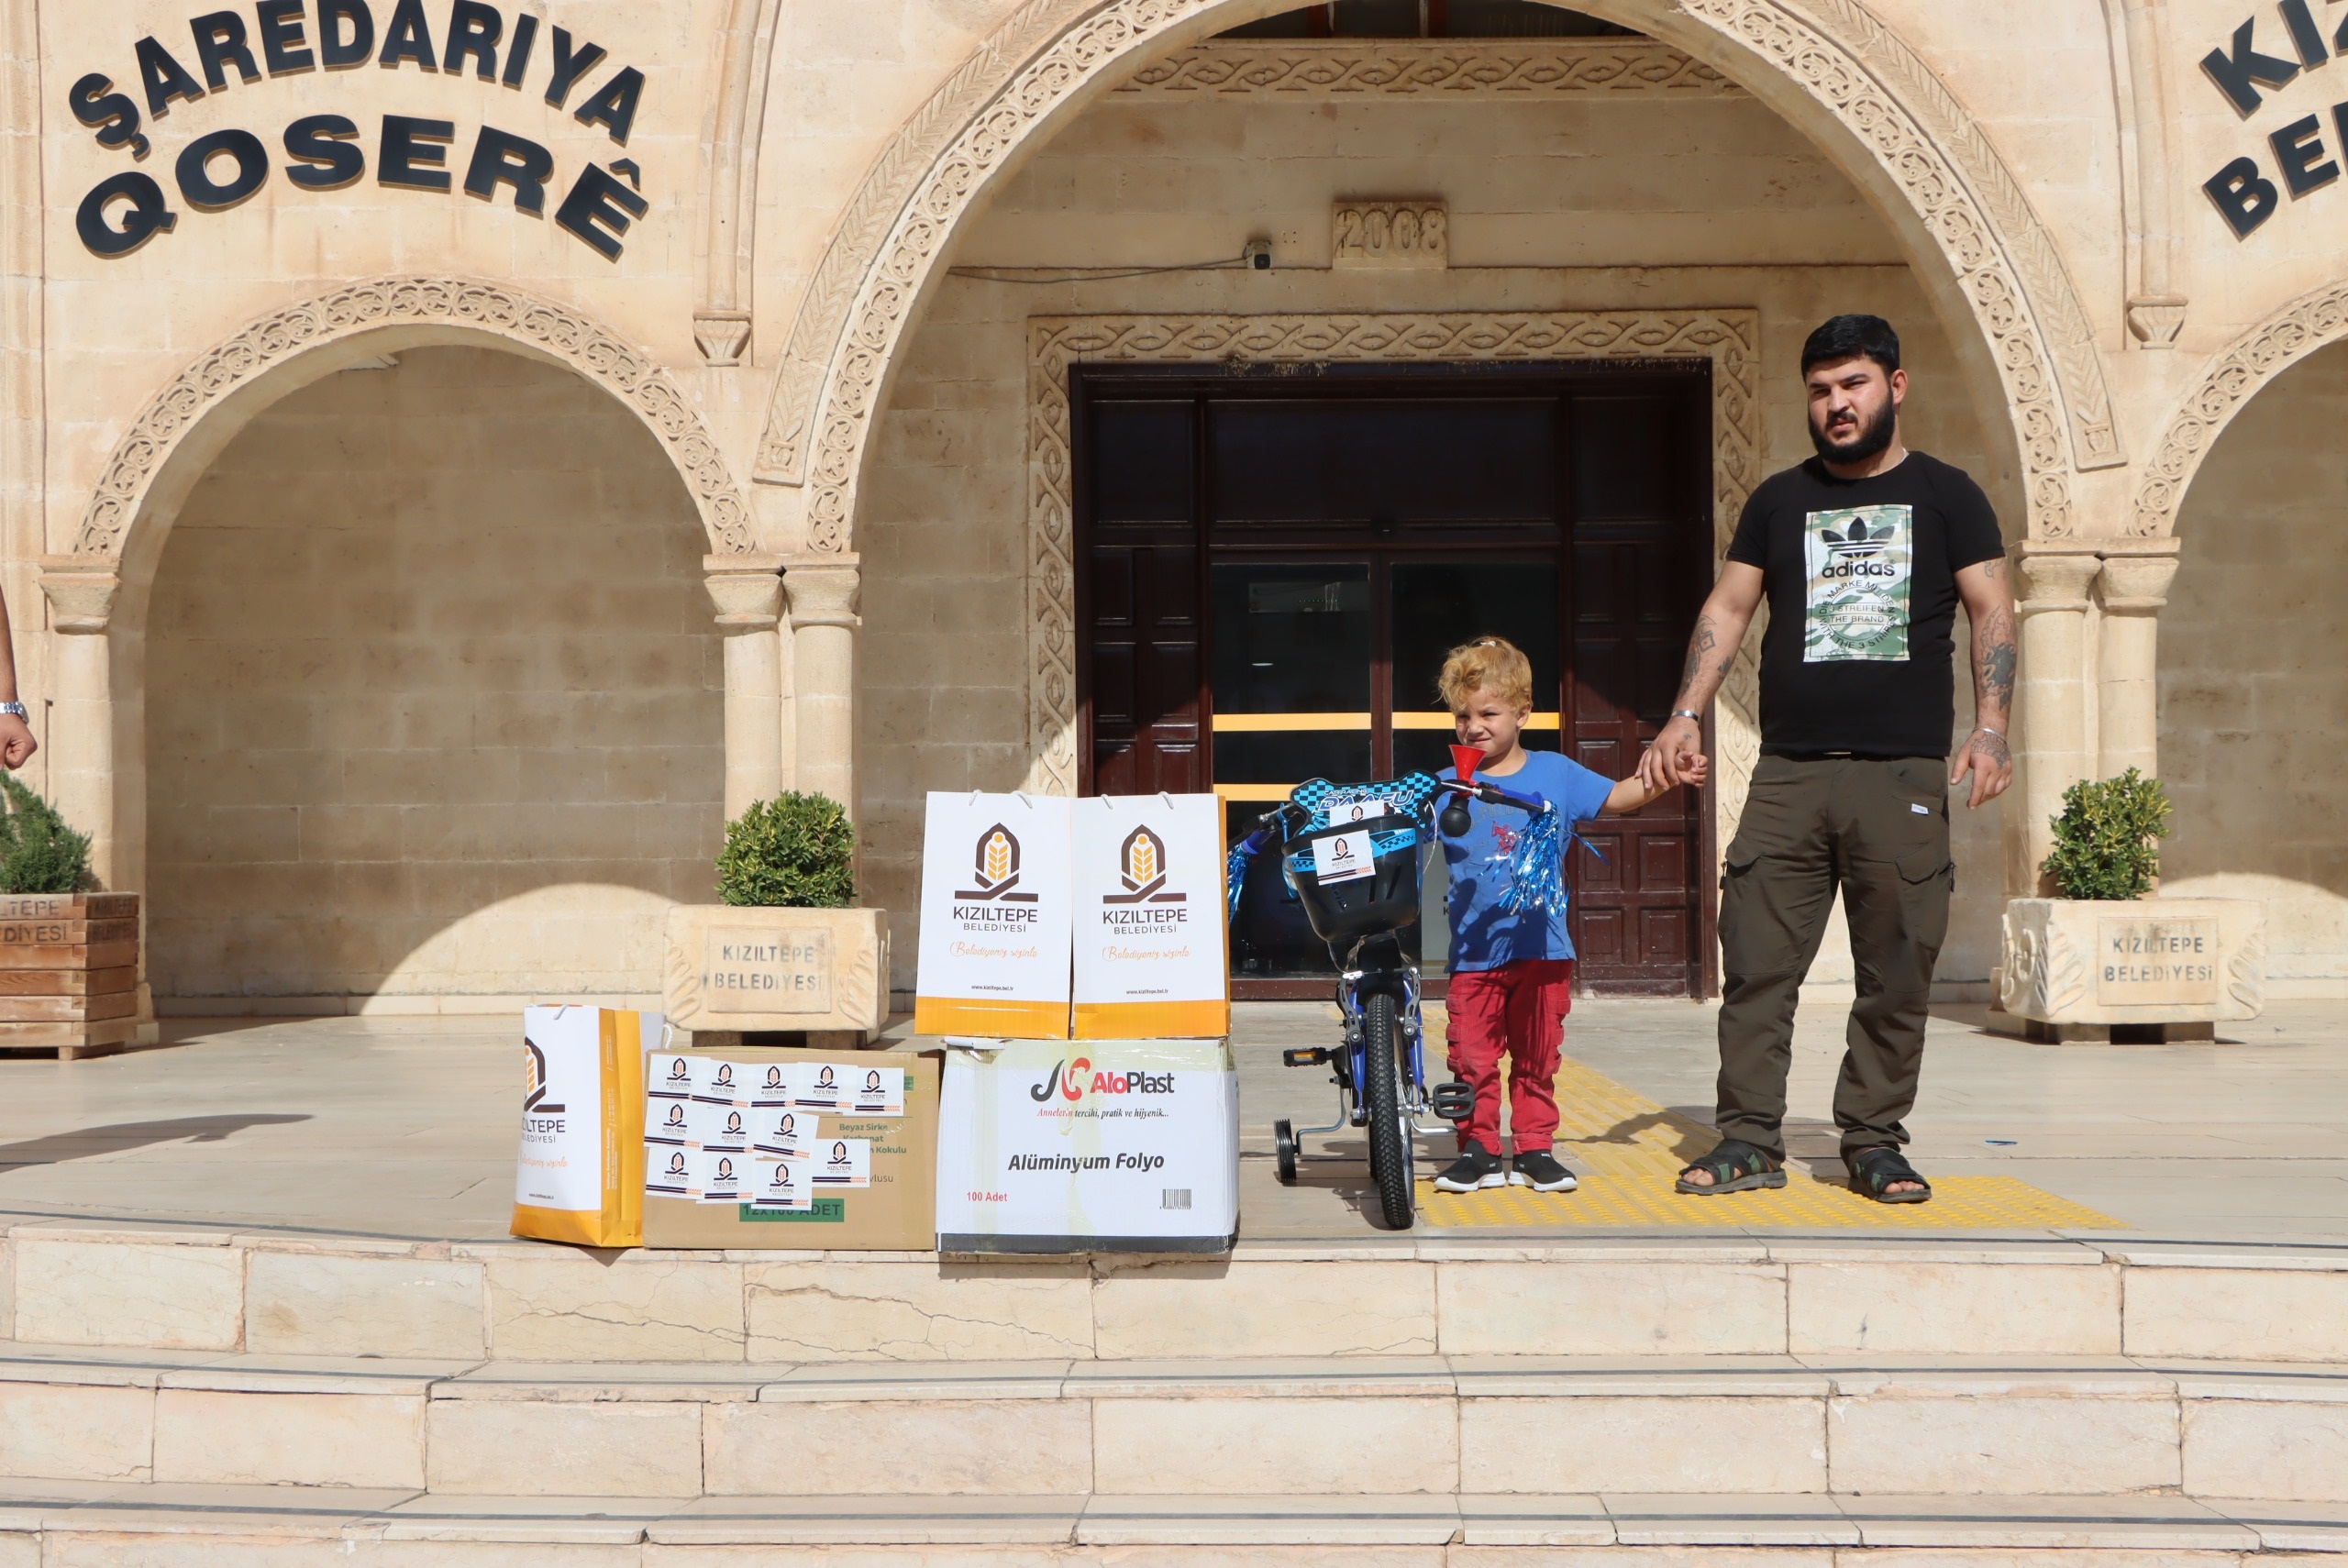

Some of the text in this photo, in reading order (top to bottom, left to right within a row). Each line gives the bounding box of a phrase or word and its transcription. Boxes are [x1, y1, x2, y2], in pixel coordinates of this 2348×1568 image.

[69, 0, 646, 160] ŞAREDARIYA
[75, 114, 649, 262] QOSERÊ
[1335, 208, 1446, 259] 2008
[1822, 560, 1895, 579] adidas
[1827, 580, 1862, 599] MARKE
[1881, 593, 1896, 613] DEN
[1834, 636, 1855, 649] THE
[0, 900, 61, 916] TEPE
[953, 906, 1038, 922] KIZILTEPE
[1102, 908, 1188, 925] KIZILTEPE
[963, 922, 1026, 933] BELEDİYESİ
[1113, 923, 1177, 935] BELEDİYESİ
[723, 944, 814, 963] KIZILTEPE
[2112, 937, 2204, 954] KIZILTEPE
[714, 972, 823, 991] BELEDİYESİ
[2104, 965, 2213, 982] BELEDİYESİ
[1090, 1071, 1175, 1095] AloPlast
[1101, 1108, 1123, 1119] pratik
[839, 1123, 864, 1132] Beyaz
[1008, 1153, 1165, 1174] Alüminyum Folyo
[967, 1191, 1008, 1202] 100 Adet
